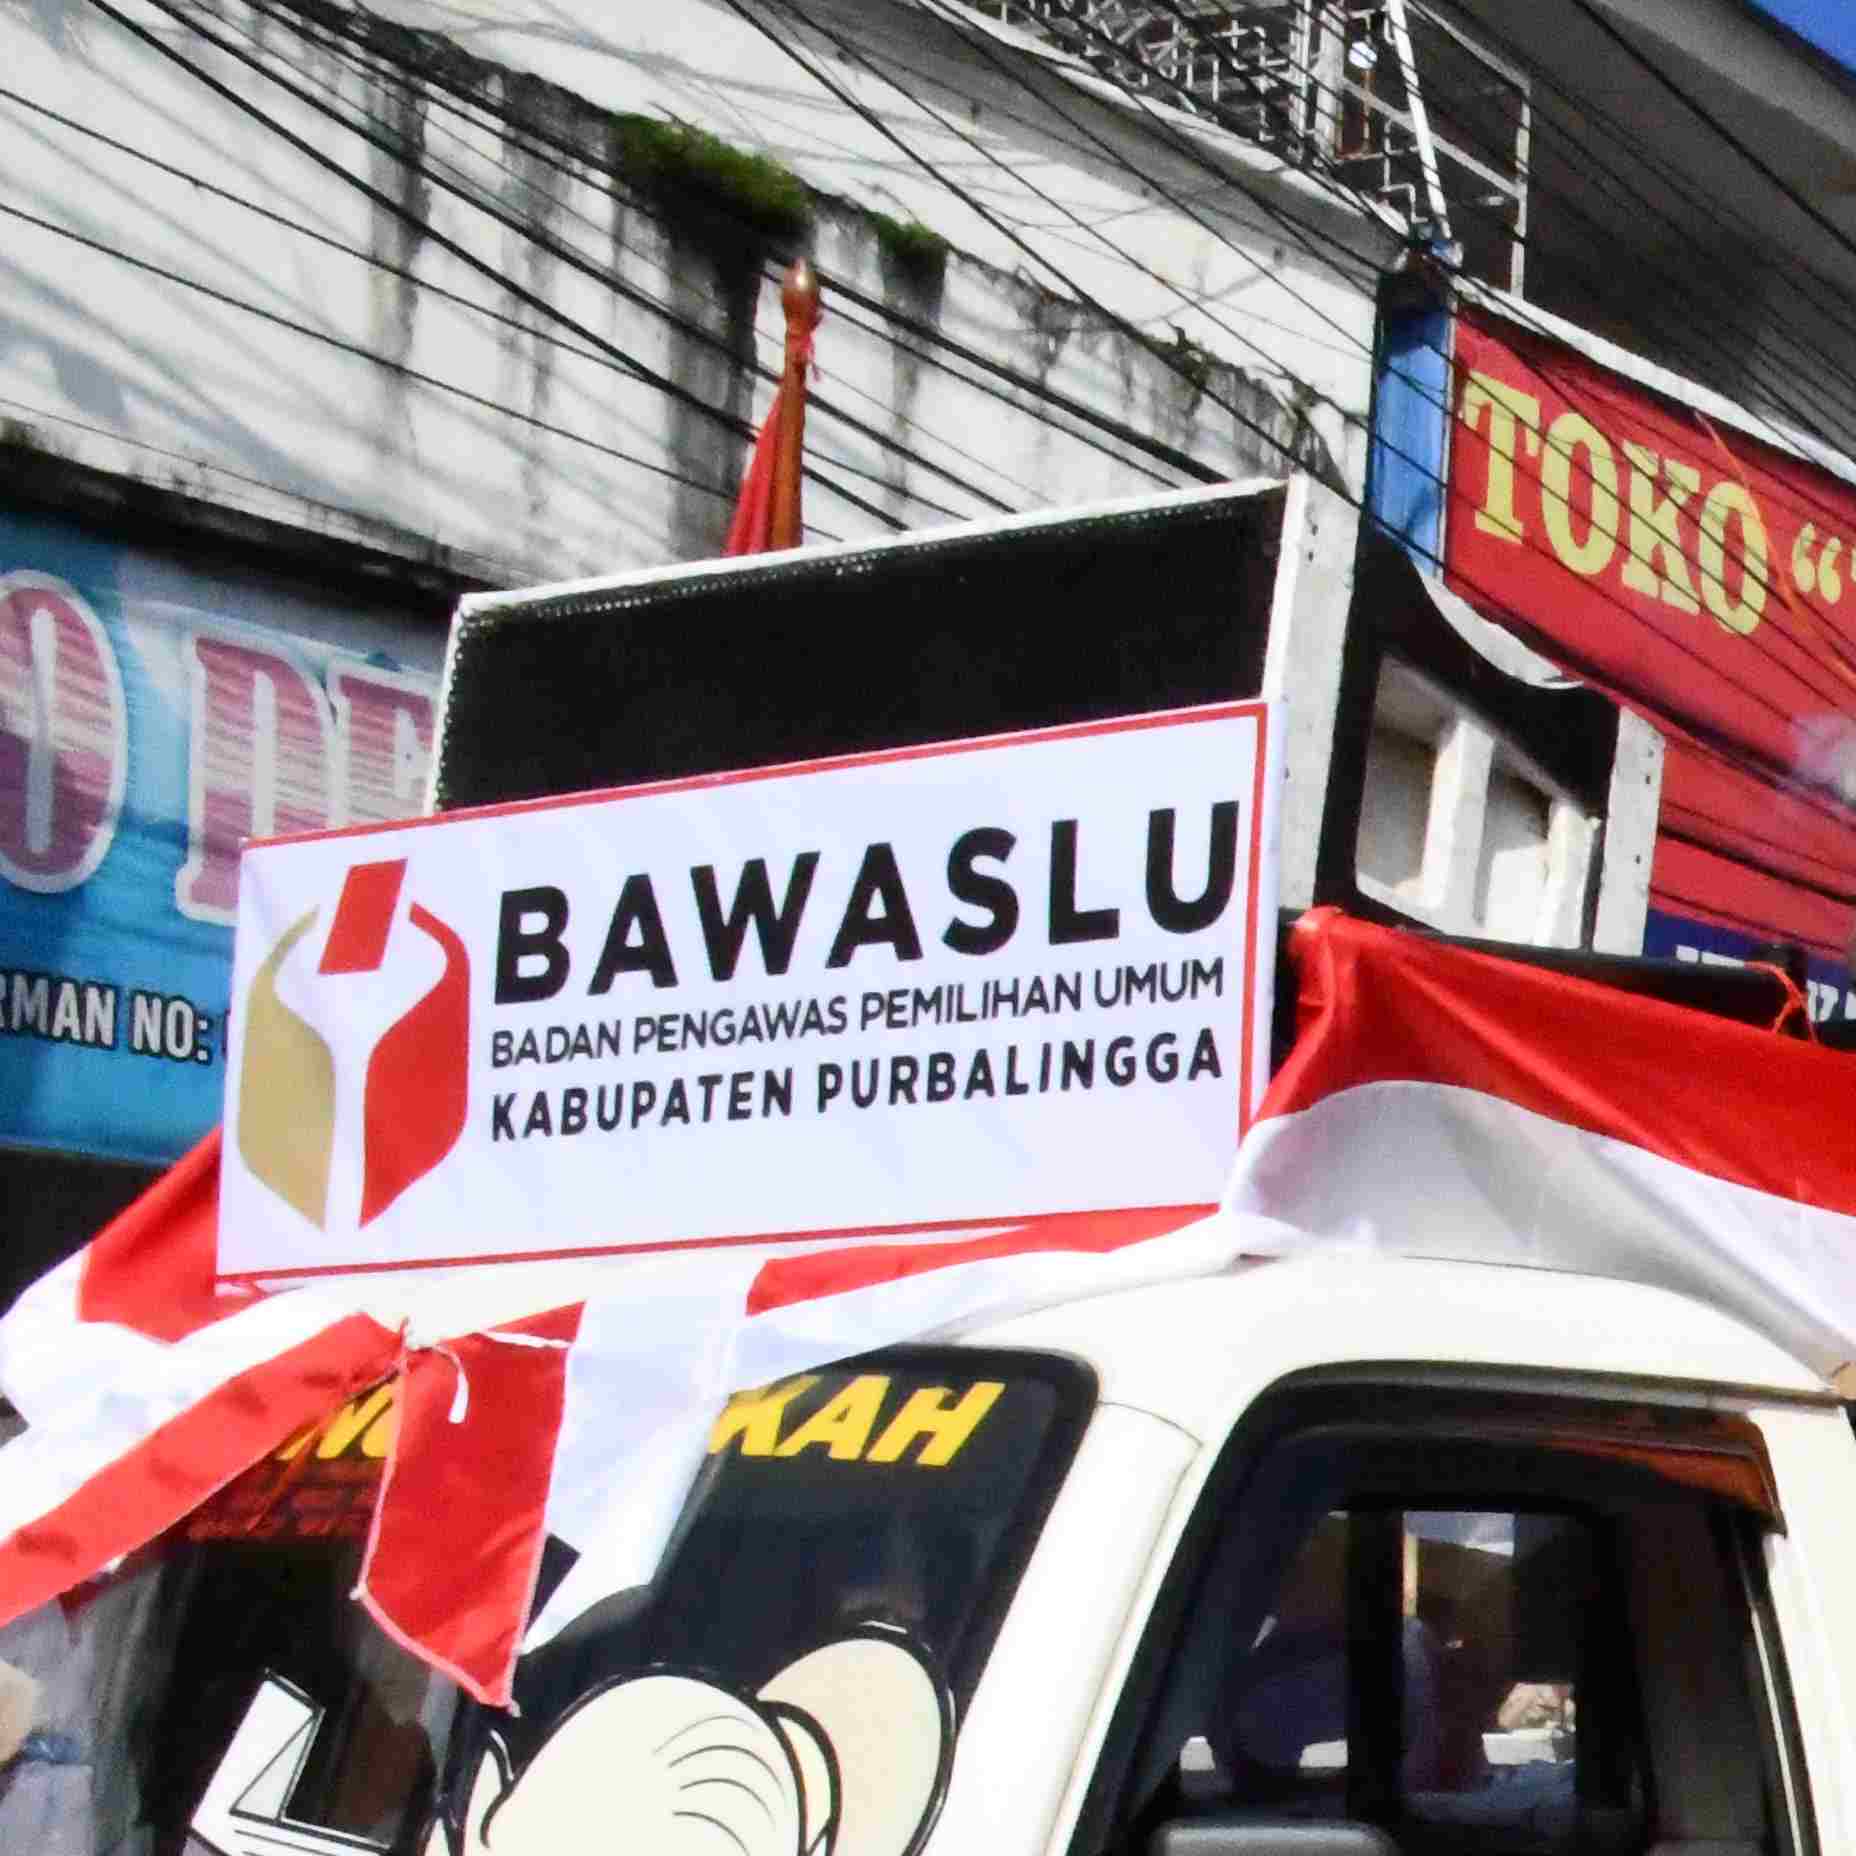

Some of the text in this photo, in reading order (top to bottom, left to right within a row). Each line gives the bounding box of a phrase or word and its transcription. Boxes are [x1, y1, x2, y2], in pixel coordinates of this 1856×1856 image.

[1462, 370, 1769, 635] TOKO
[495, 799, 1240, 1005] BAWASLU
[132, 996, 211, 1063] NO:
[491, 957, 1224, 1068] BADAN PENGAWAS PEMILIHAN UMUM
[492, 1027, 1222, 1142] KABUPATEN PURBALINGGA
